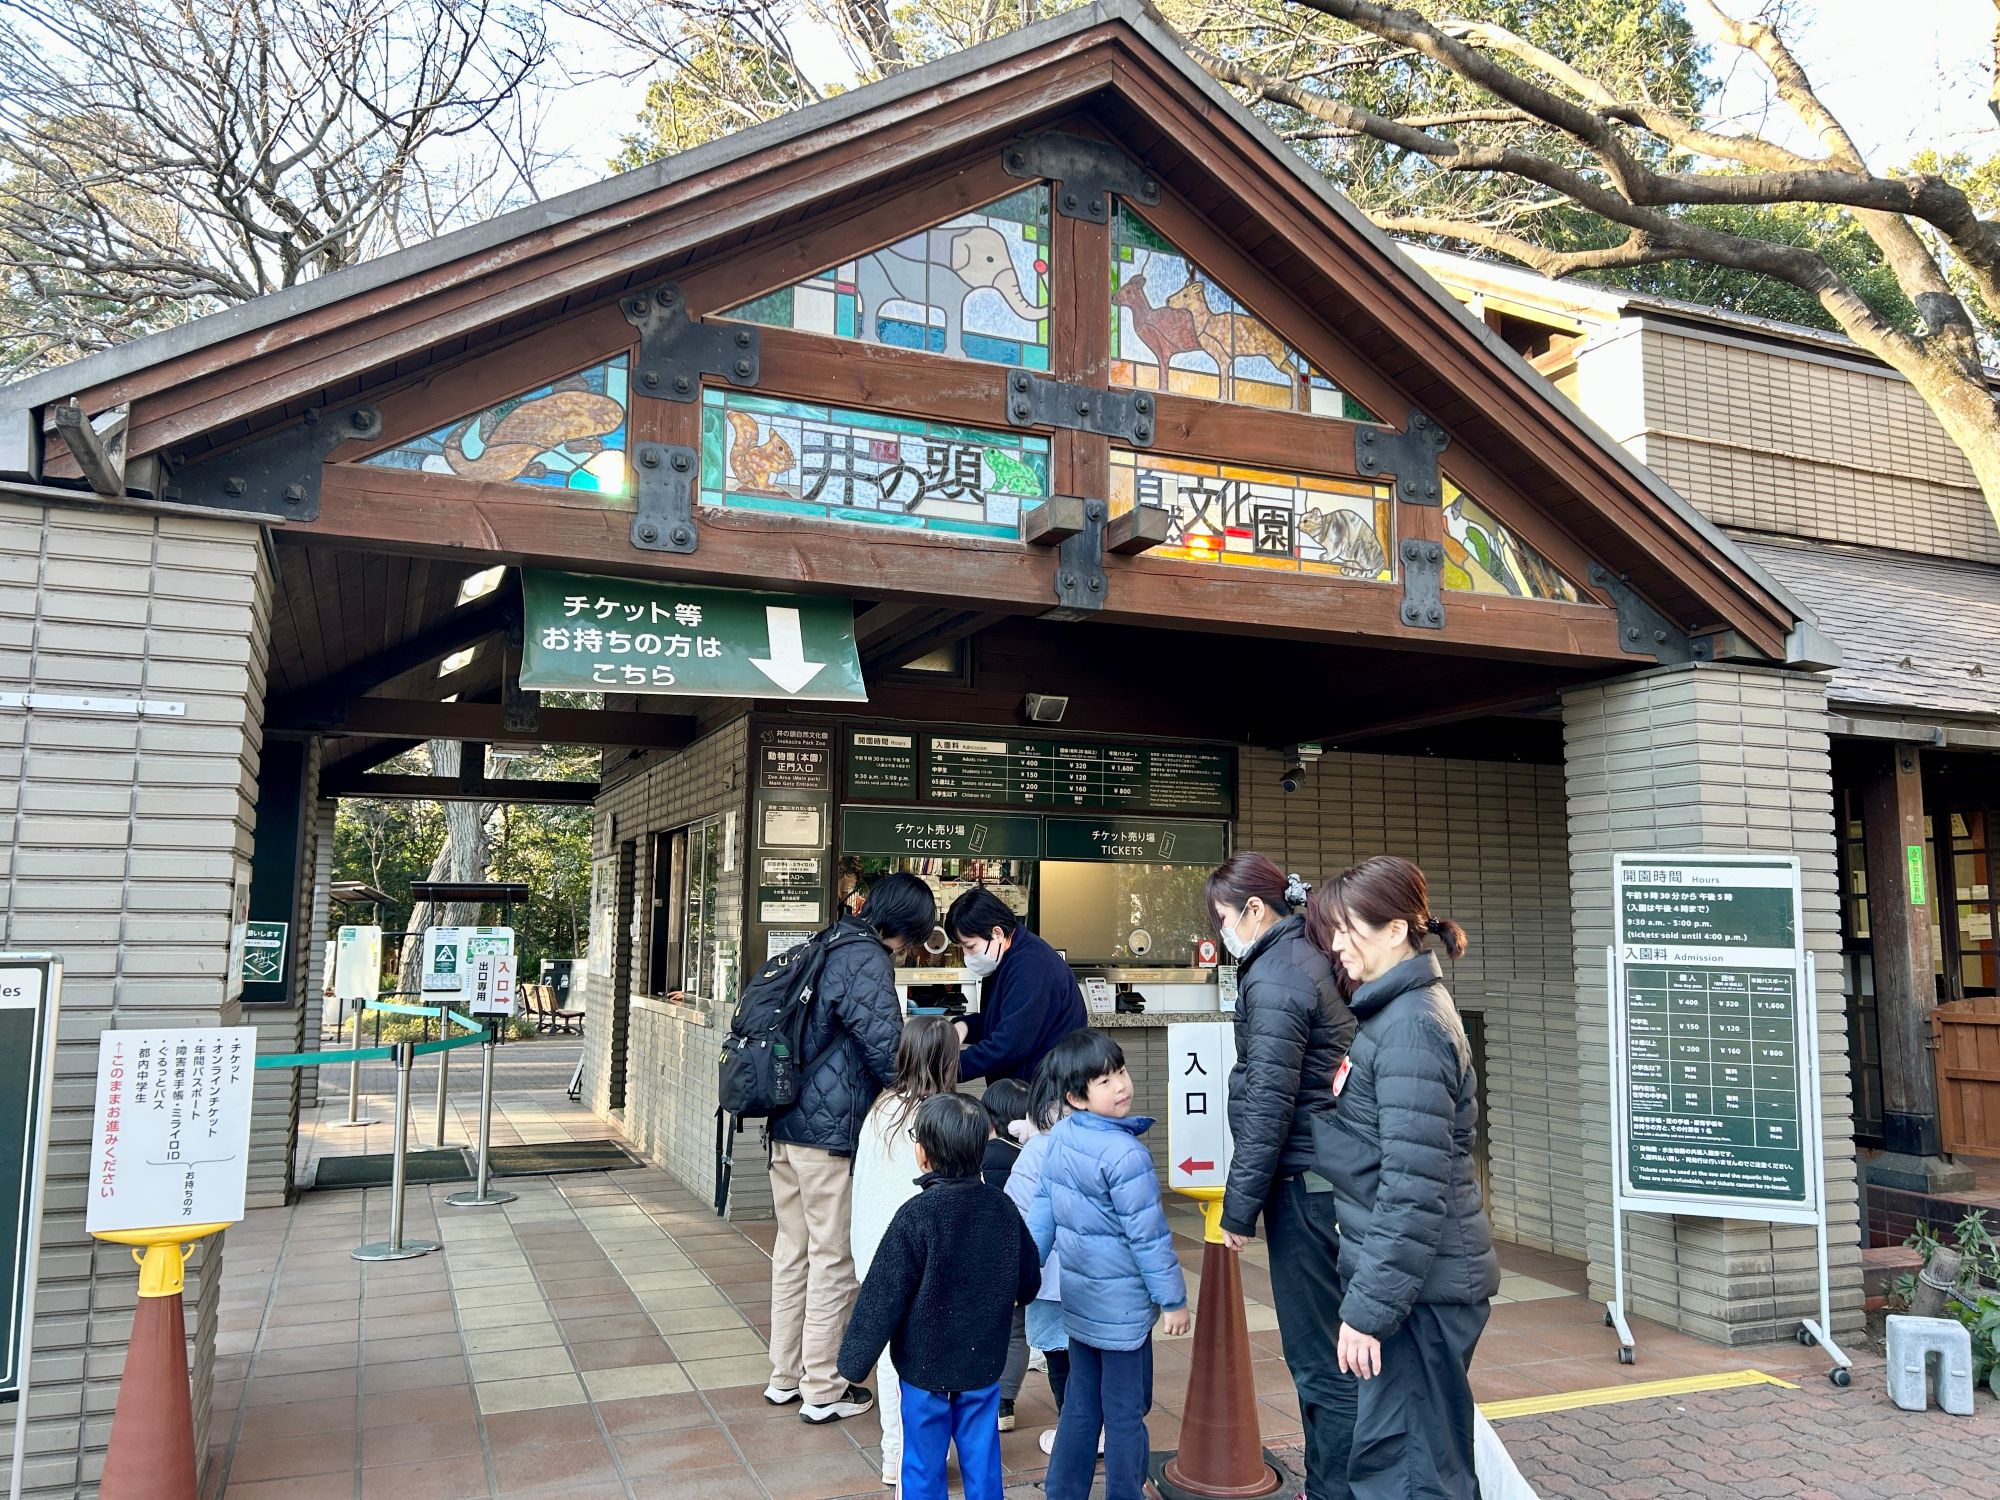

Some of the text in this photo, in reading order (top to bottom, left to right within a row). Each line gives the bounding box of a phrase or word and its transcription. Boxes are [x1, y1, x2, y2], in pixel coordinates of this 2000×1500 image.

[803, 434, 985, 513] 井の頭
[563, 595, 702, 627] チケット等
[542, 627, 723, 658] お持ちの方は
[592, 663, 676, 686] こちら
[776, 730, 828, 739] 井の頭自然文化園
[777, 763, 814, 772] 正門入口
[895, 823, 965, 836] チケット売り場
[1091, 830, 1156, 843] チケット売り場
[905, 839, 951, 849] TICKETS
[1101, 845, 1143, 856] TICKETS
[1623, 870, 1720, 884] 開園時間 Hours
[1627, 918, 1645, 926] 9:30
[1725, 934, 1748, 942] p.m.)
[1625, 947, 1724, 962] 入園料 Admission
[476, 962, 488, 1001] 出口専用
[497, 962, 510, 991] 入口
[1184, 1052, 1208, 1115] 入口
[101, 1055, 124, 1199] このままお進みください
[182, 1171, 195, 1216] お持ちの方
